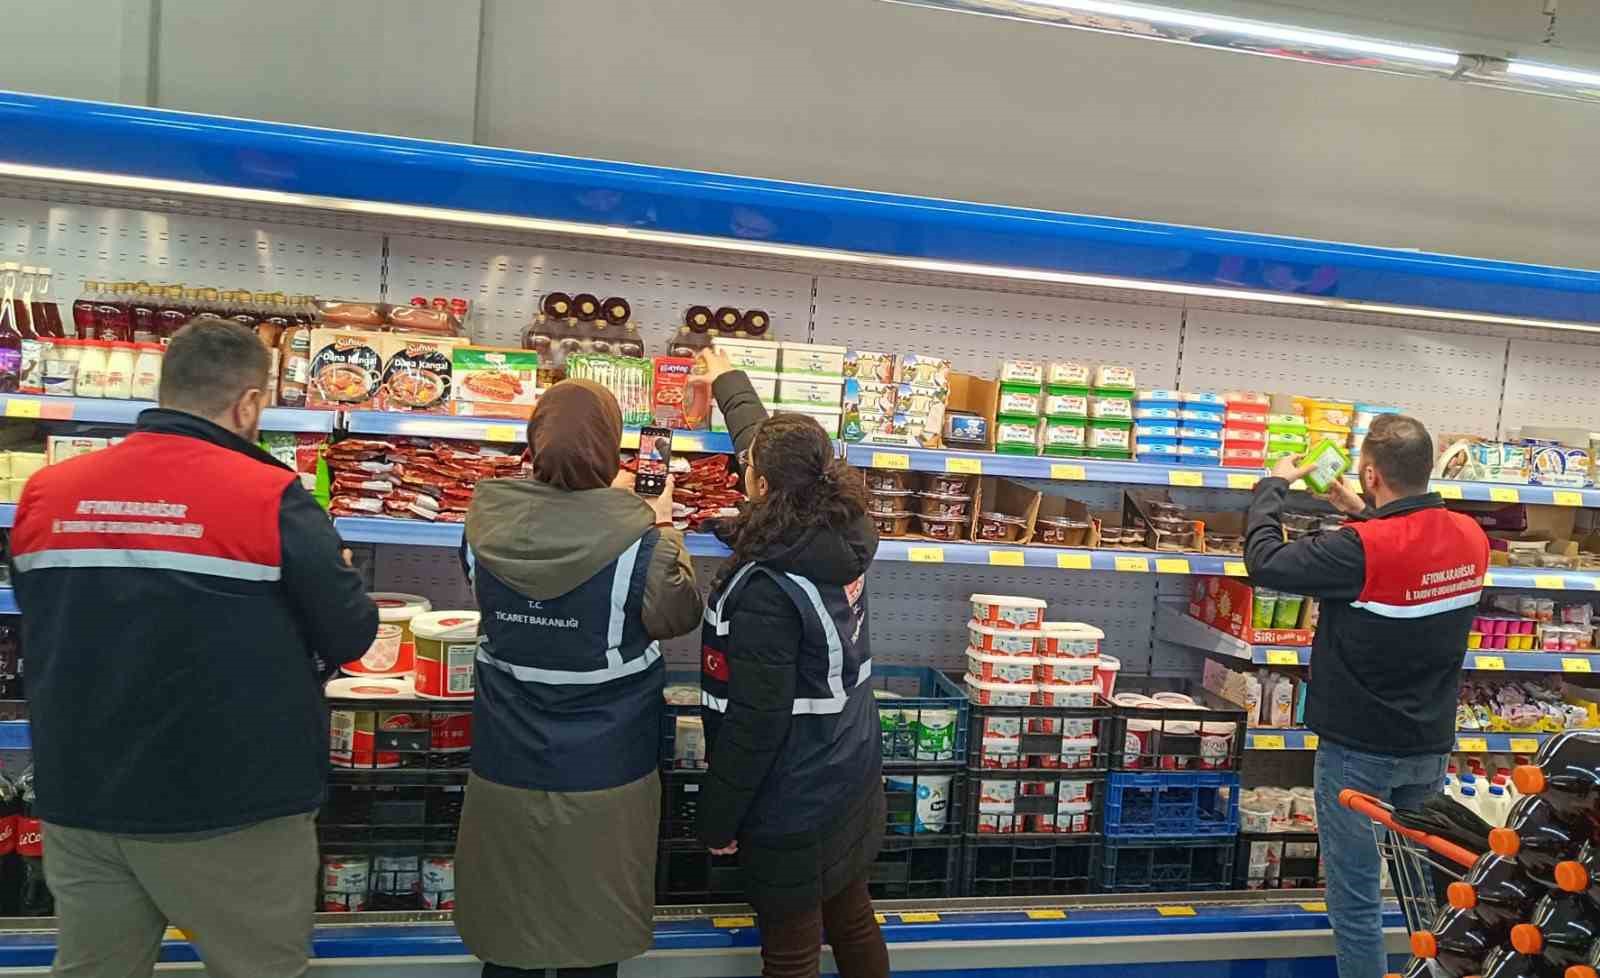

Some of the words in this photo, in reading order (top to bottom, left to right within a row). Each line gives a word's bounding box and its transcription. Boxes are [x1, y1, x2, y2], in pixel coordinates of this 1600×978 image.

[322, 352, 345, 362] Dana
[394, 359, 416, 369] Dana
[418, 361, 448, 371] Kangal
[529, 616, 579, 629] BAKANLIĞI
